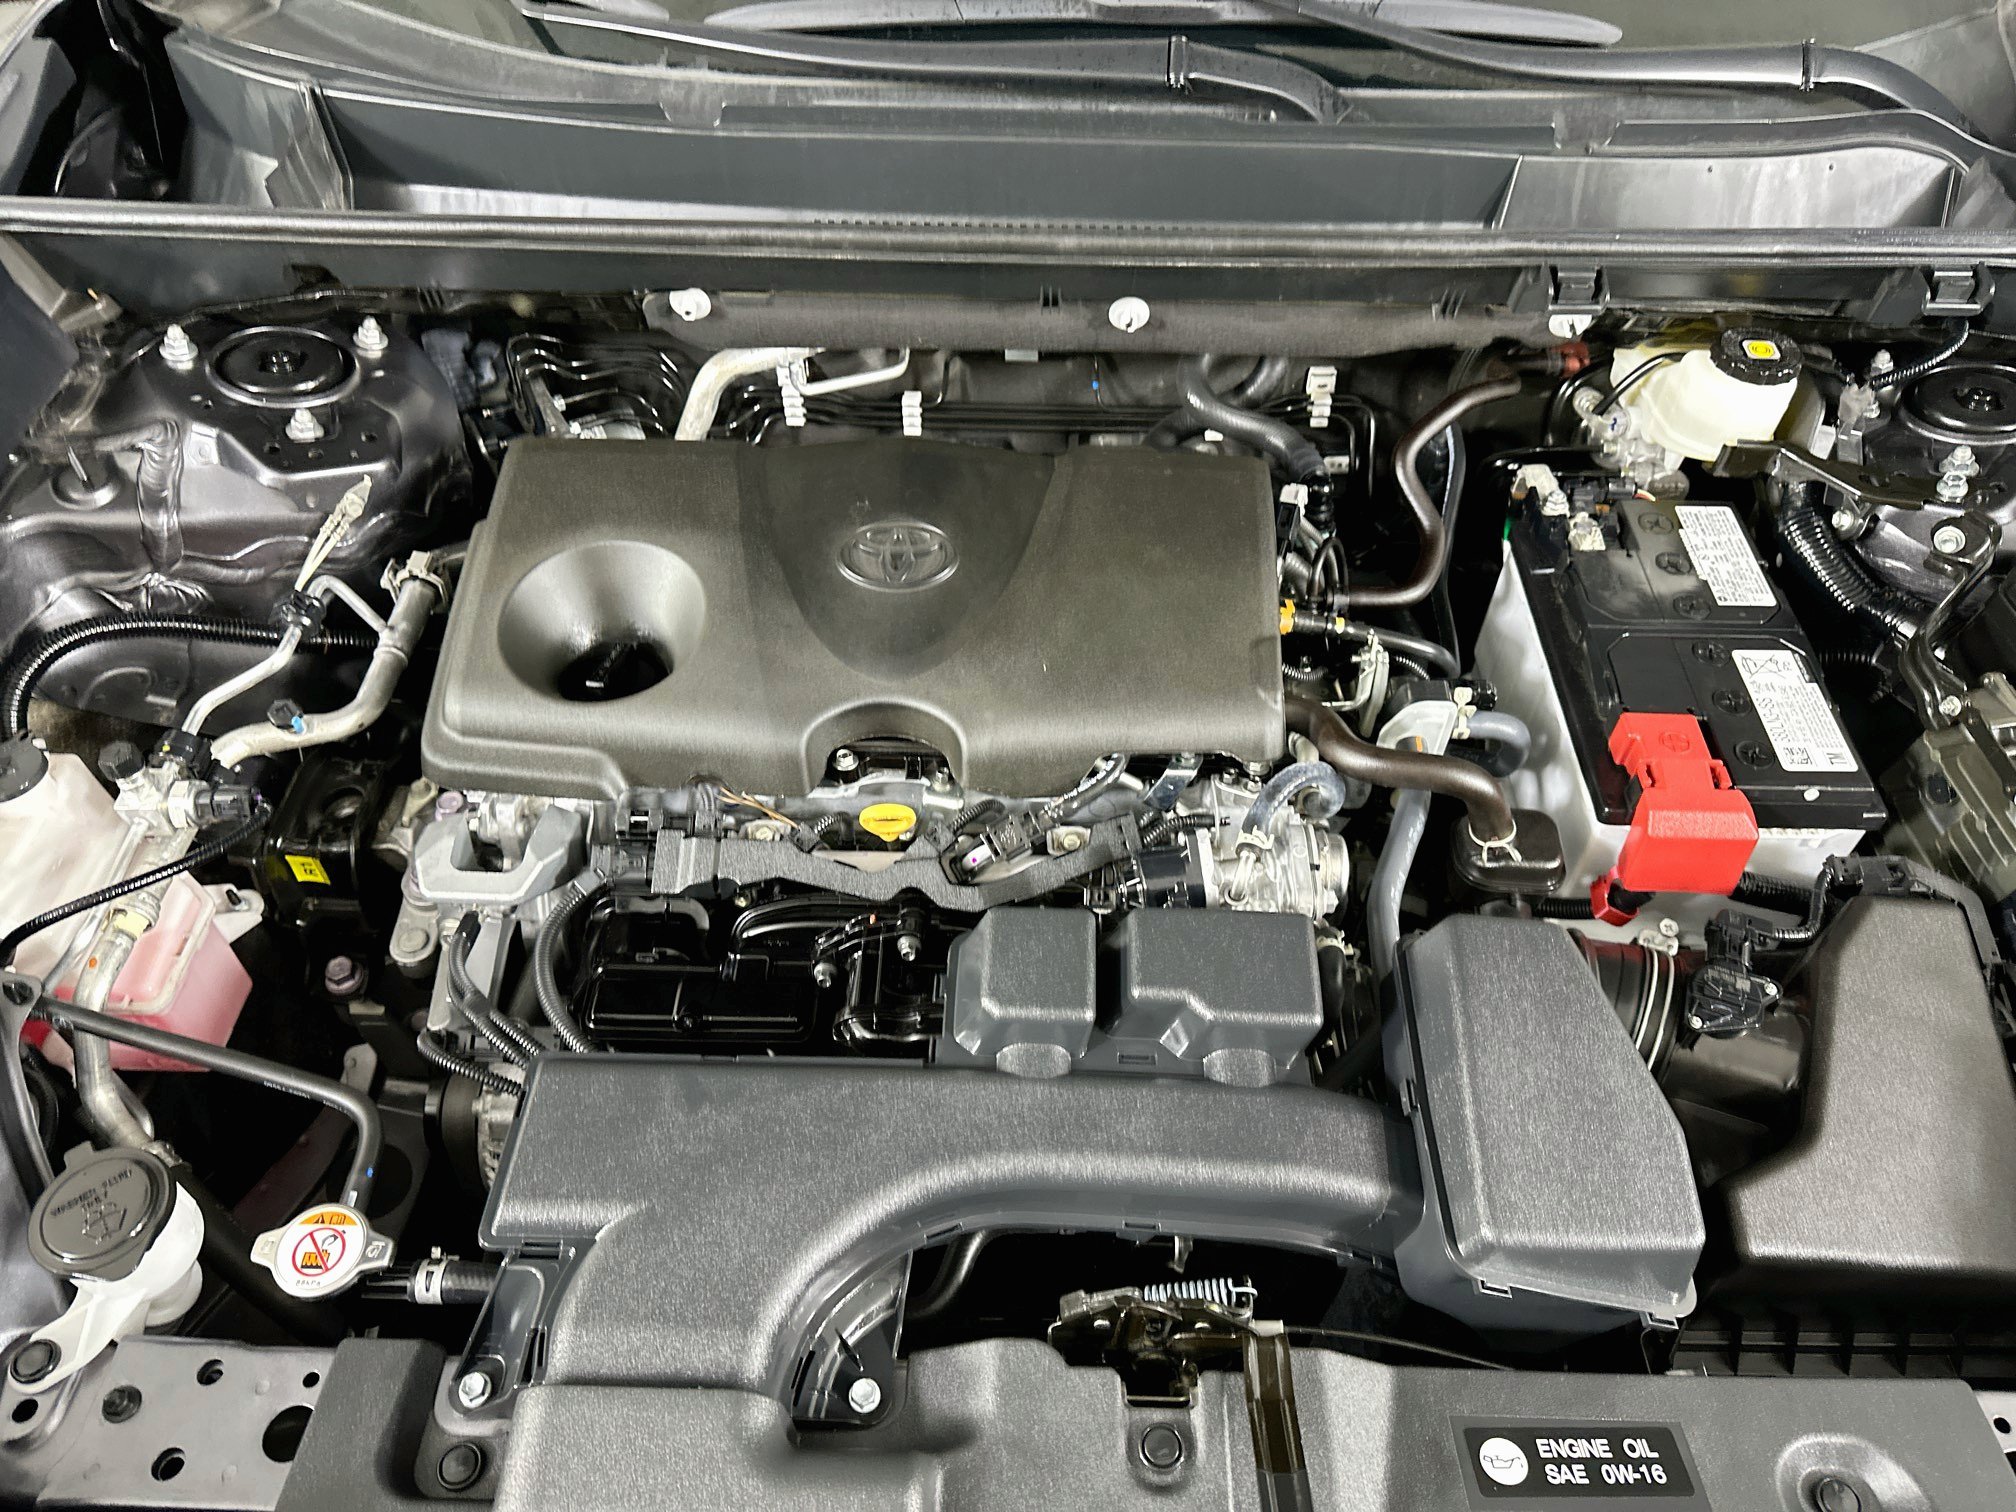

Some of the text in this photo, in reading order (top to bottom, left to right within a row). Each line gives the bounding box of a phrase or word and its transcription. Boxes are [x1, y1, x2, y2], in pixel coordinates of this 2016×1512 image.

[1535, 1438, 1659, 1459] ENGINE OIL
[1544, 1464, 1668, 1485] SAE 0W-16
